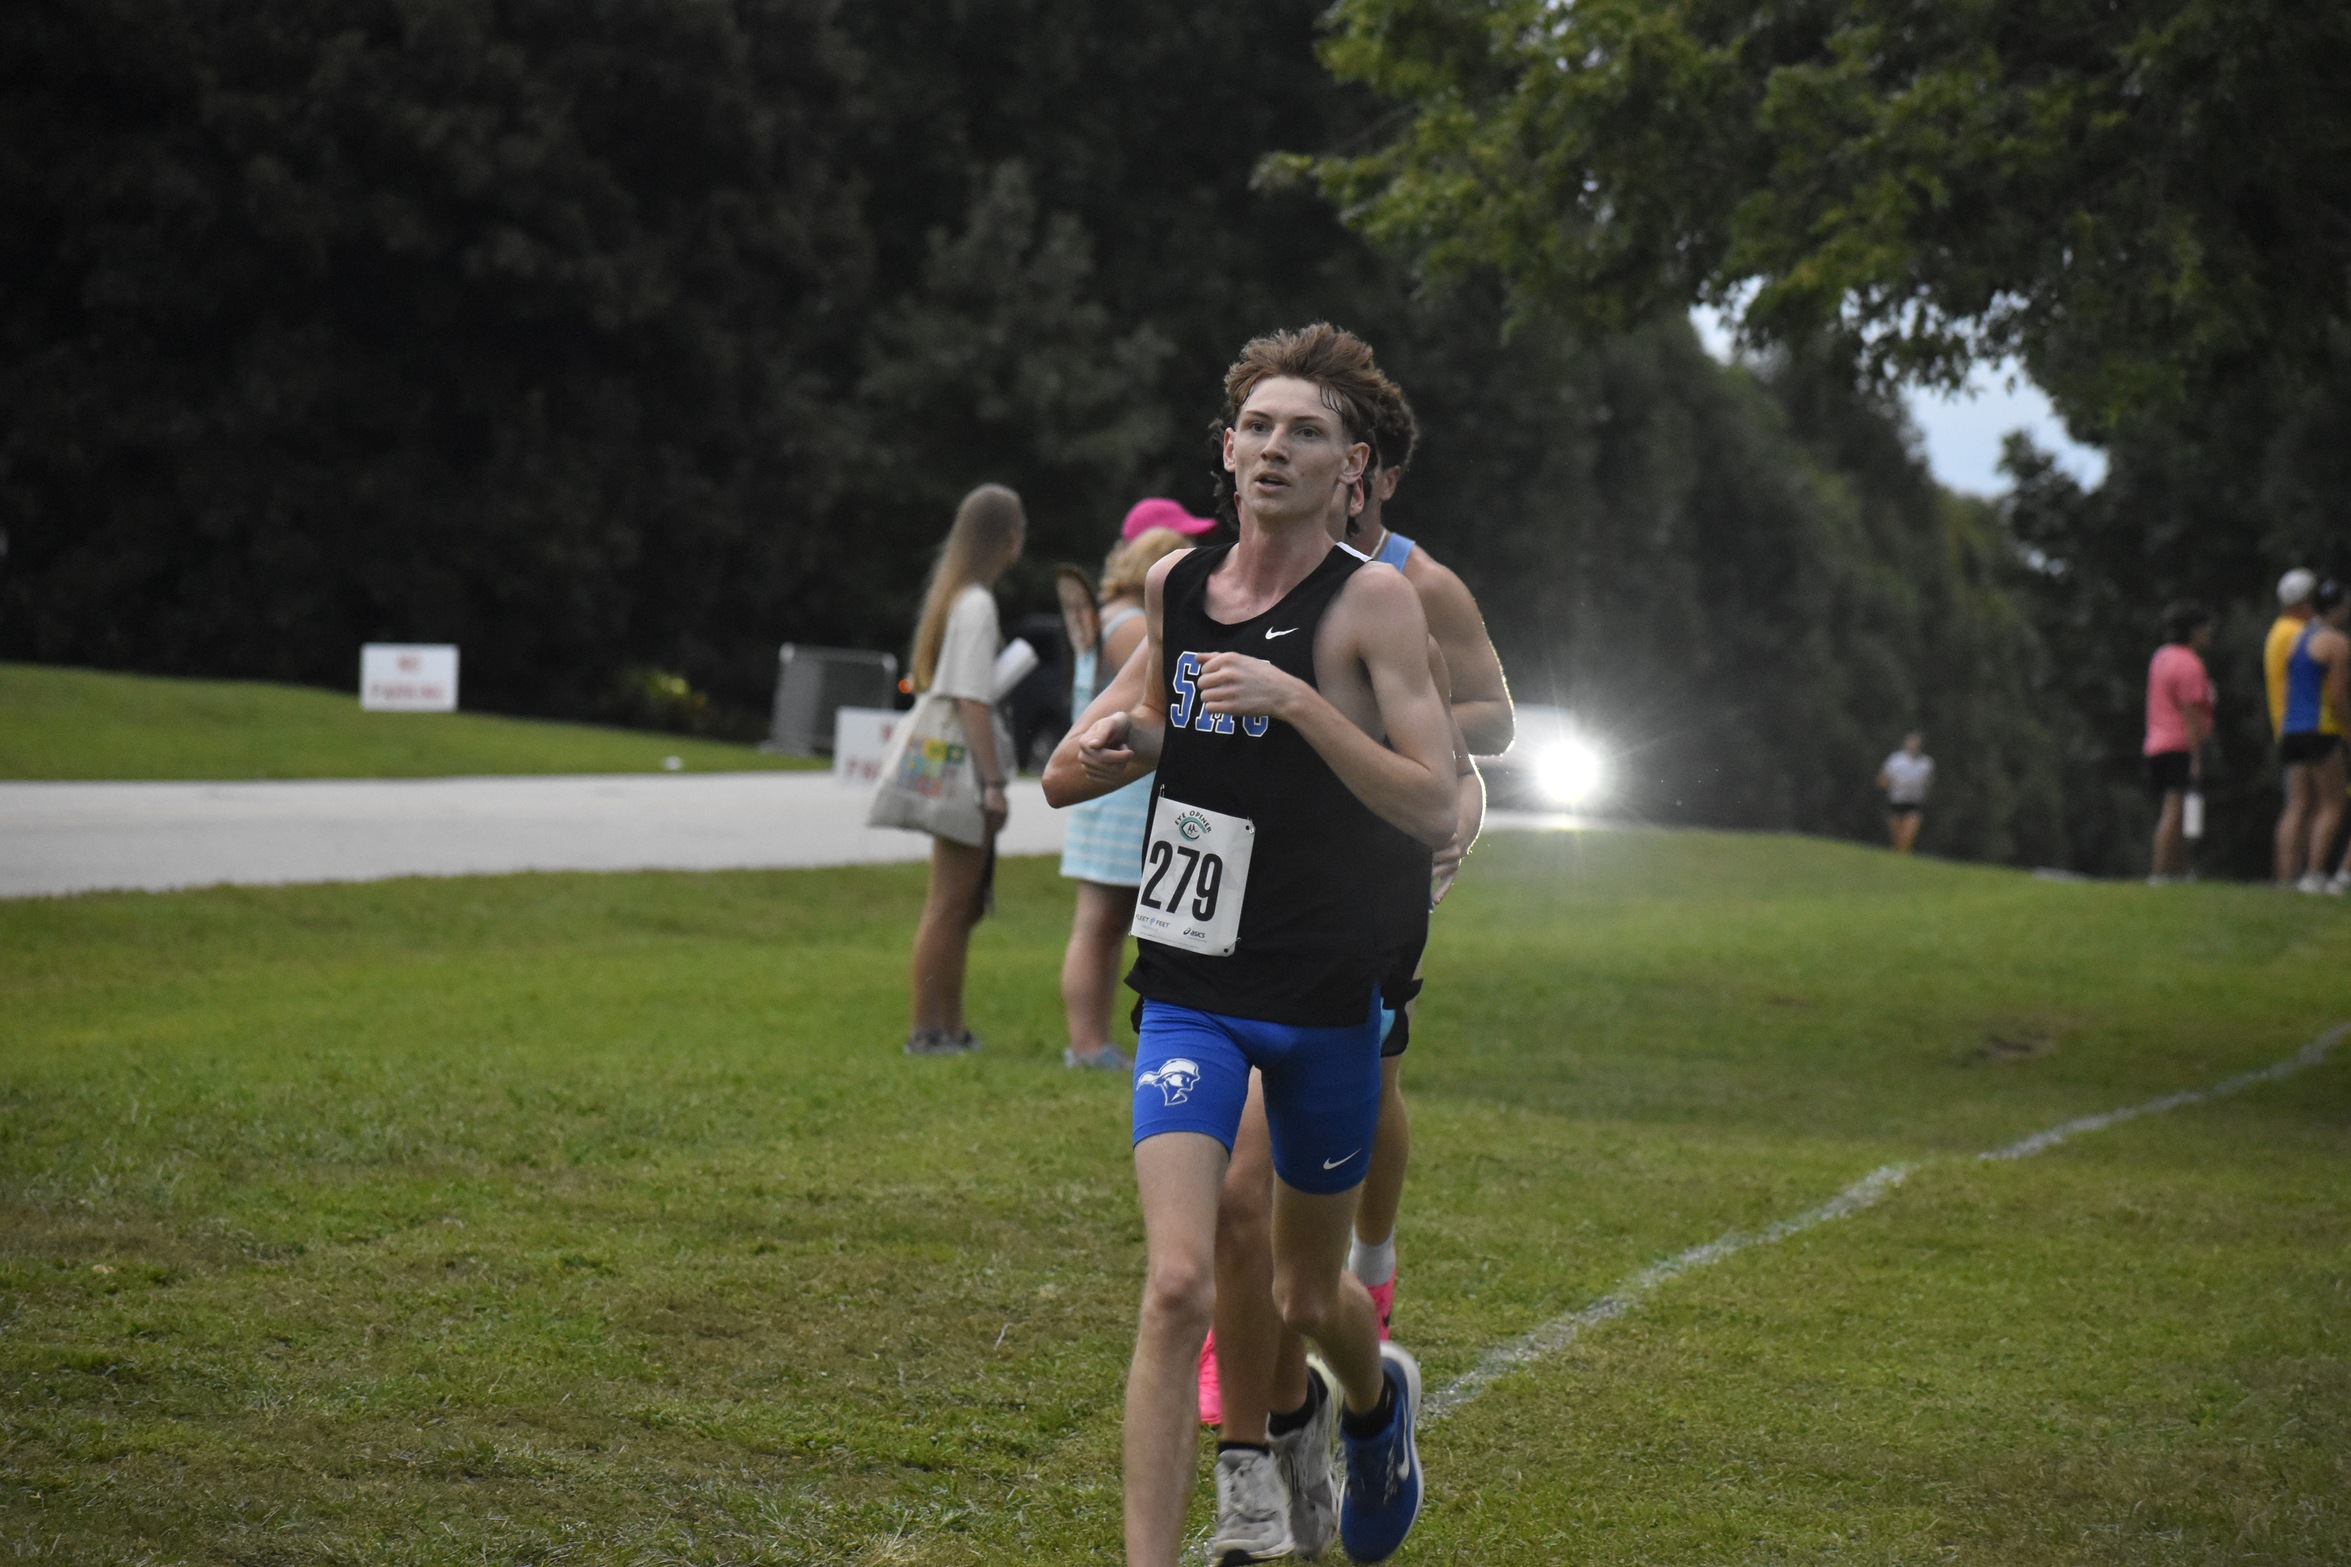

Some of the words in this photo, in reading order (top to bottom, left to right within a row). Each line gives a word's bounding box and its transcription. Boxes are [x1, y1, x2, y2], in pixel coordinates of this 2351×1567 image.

[1174, 812, 1186, 826] EYE
[1189, 810, 1212, 833] OPENER
[1140, 840, 1223, 922] 279
[1155, 919, 1170, 928] FEET
